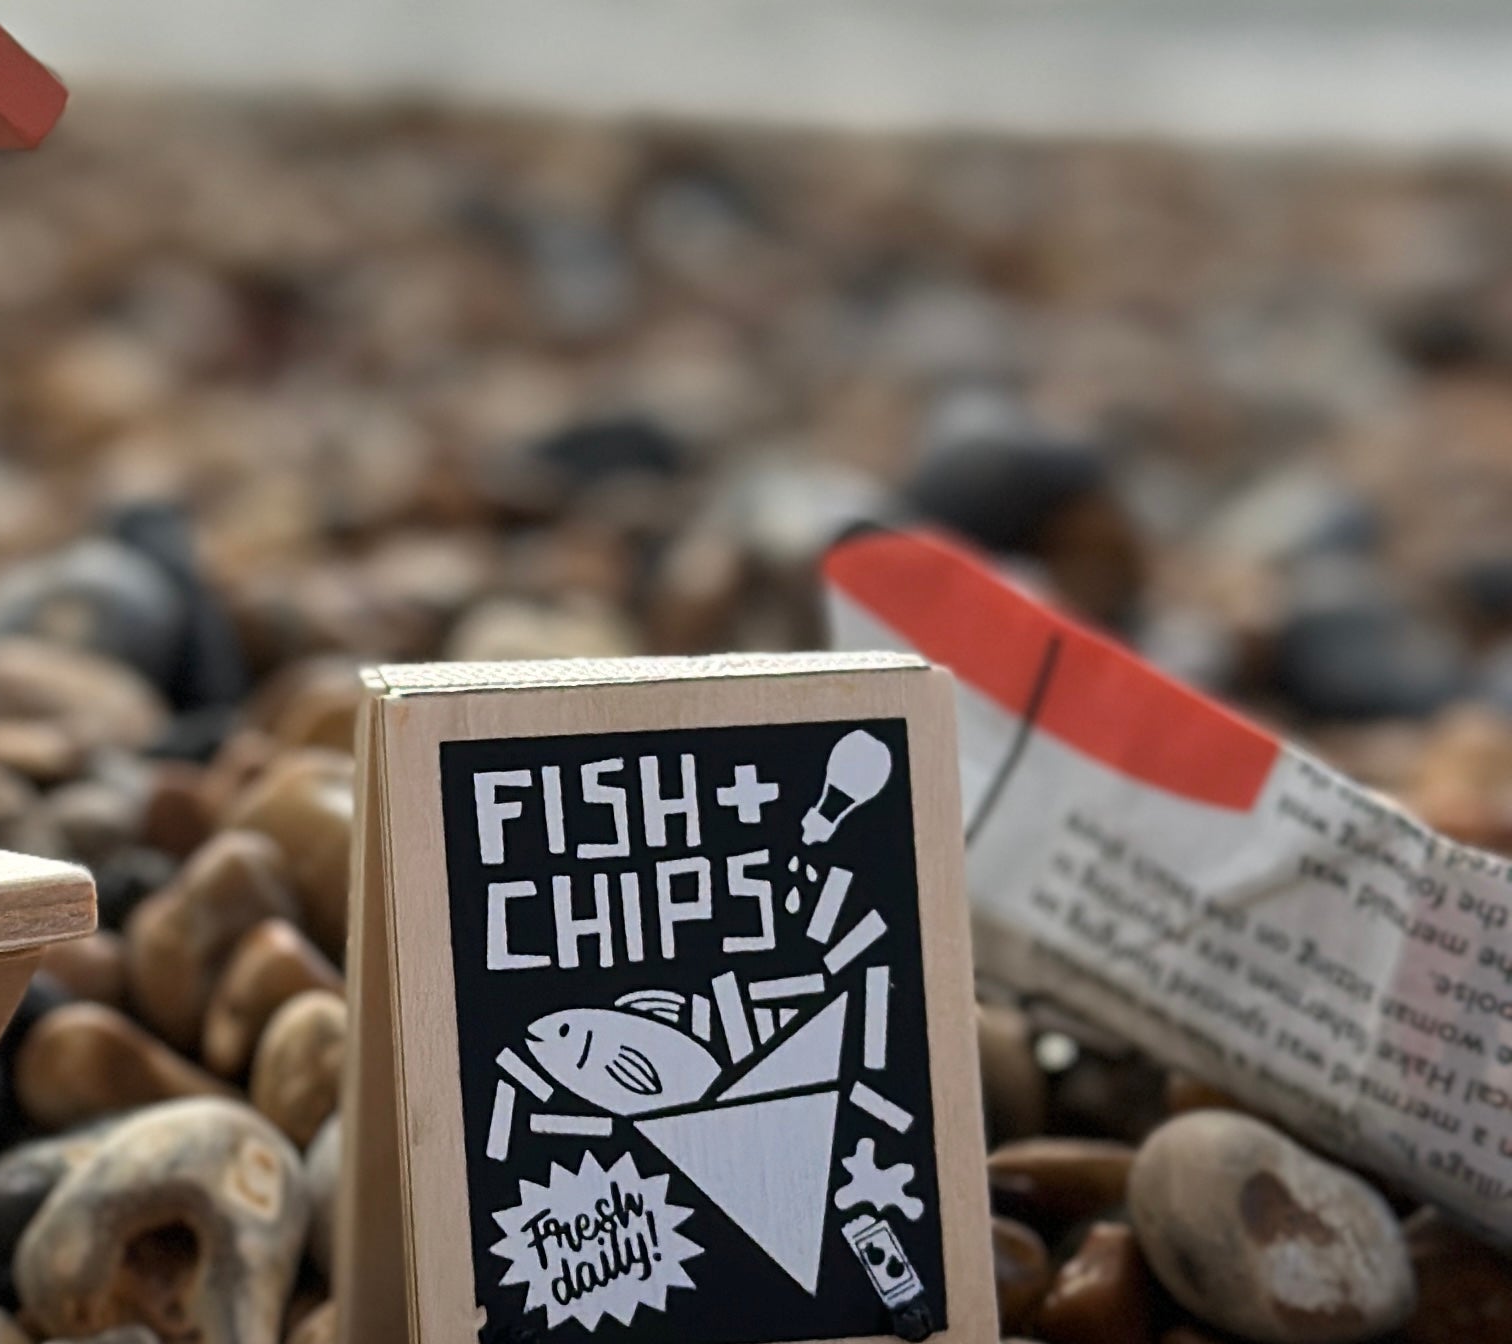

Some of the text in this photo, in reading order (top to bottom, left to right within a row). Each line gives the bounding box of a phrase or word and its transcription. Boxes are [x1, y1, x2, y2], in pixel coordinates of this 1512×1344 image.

[487, 849, 776, 970] CHIPS
[521, 1181, 643, 1269] Fresh
[552, 1211, 662, 1305] daily!
